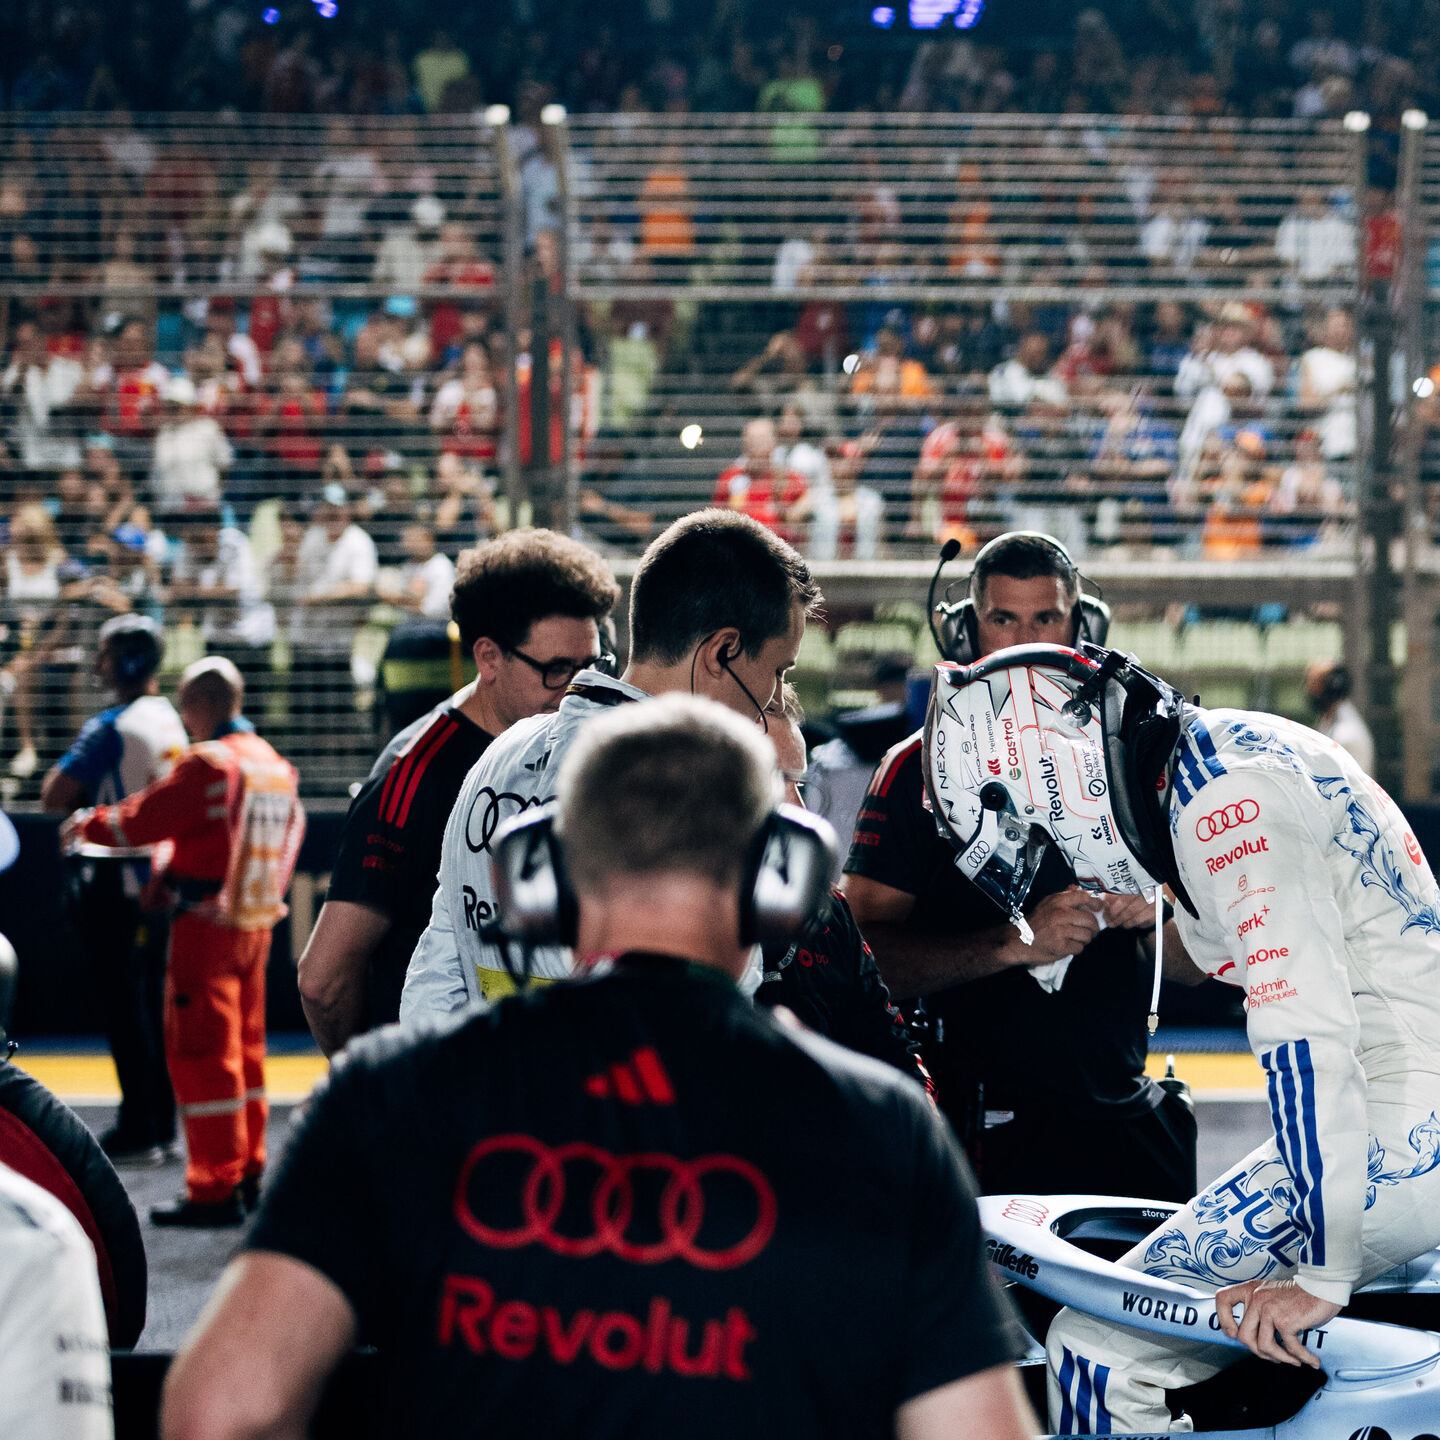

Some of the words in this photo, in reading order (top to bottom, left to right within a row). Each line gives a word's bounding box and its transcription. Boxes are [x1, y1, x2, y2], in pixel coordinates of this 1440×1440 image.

[937, 730, 949, 789] NEXO
[1001, 718, 1019, 767] Castrol
[1039, 755, 1065, 822] Revolut
[1100, 815, 1113, 846] CAMOZZI
[1107, 861, 1121, 886] visit
[1205, 836, 1269, 876] Revolut
[1246, 947, 1289, 967] aOne
[1250, 977, 1289, 997] Admin
[1250, 998, 1261, 1009] By
[1261, 988, 1299, 1004] Request
[1122, 1291, 1198, 1326] WORLD
[436, 1272, 756, 1381] Revolut
